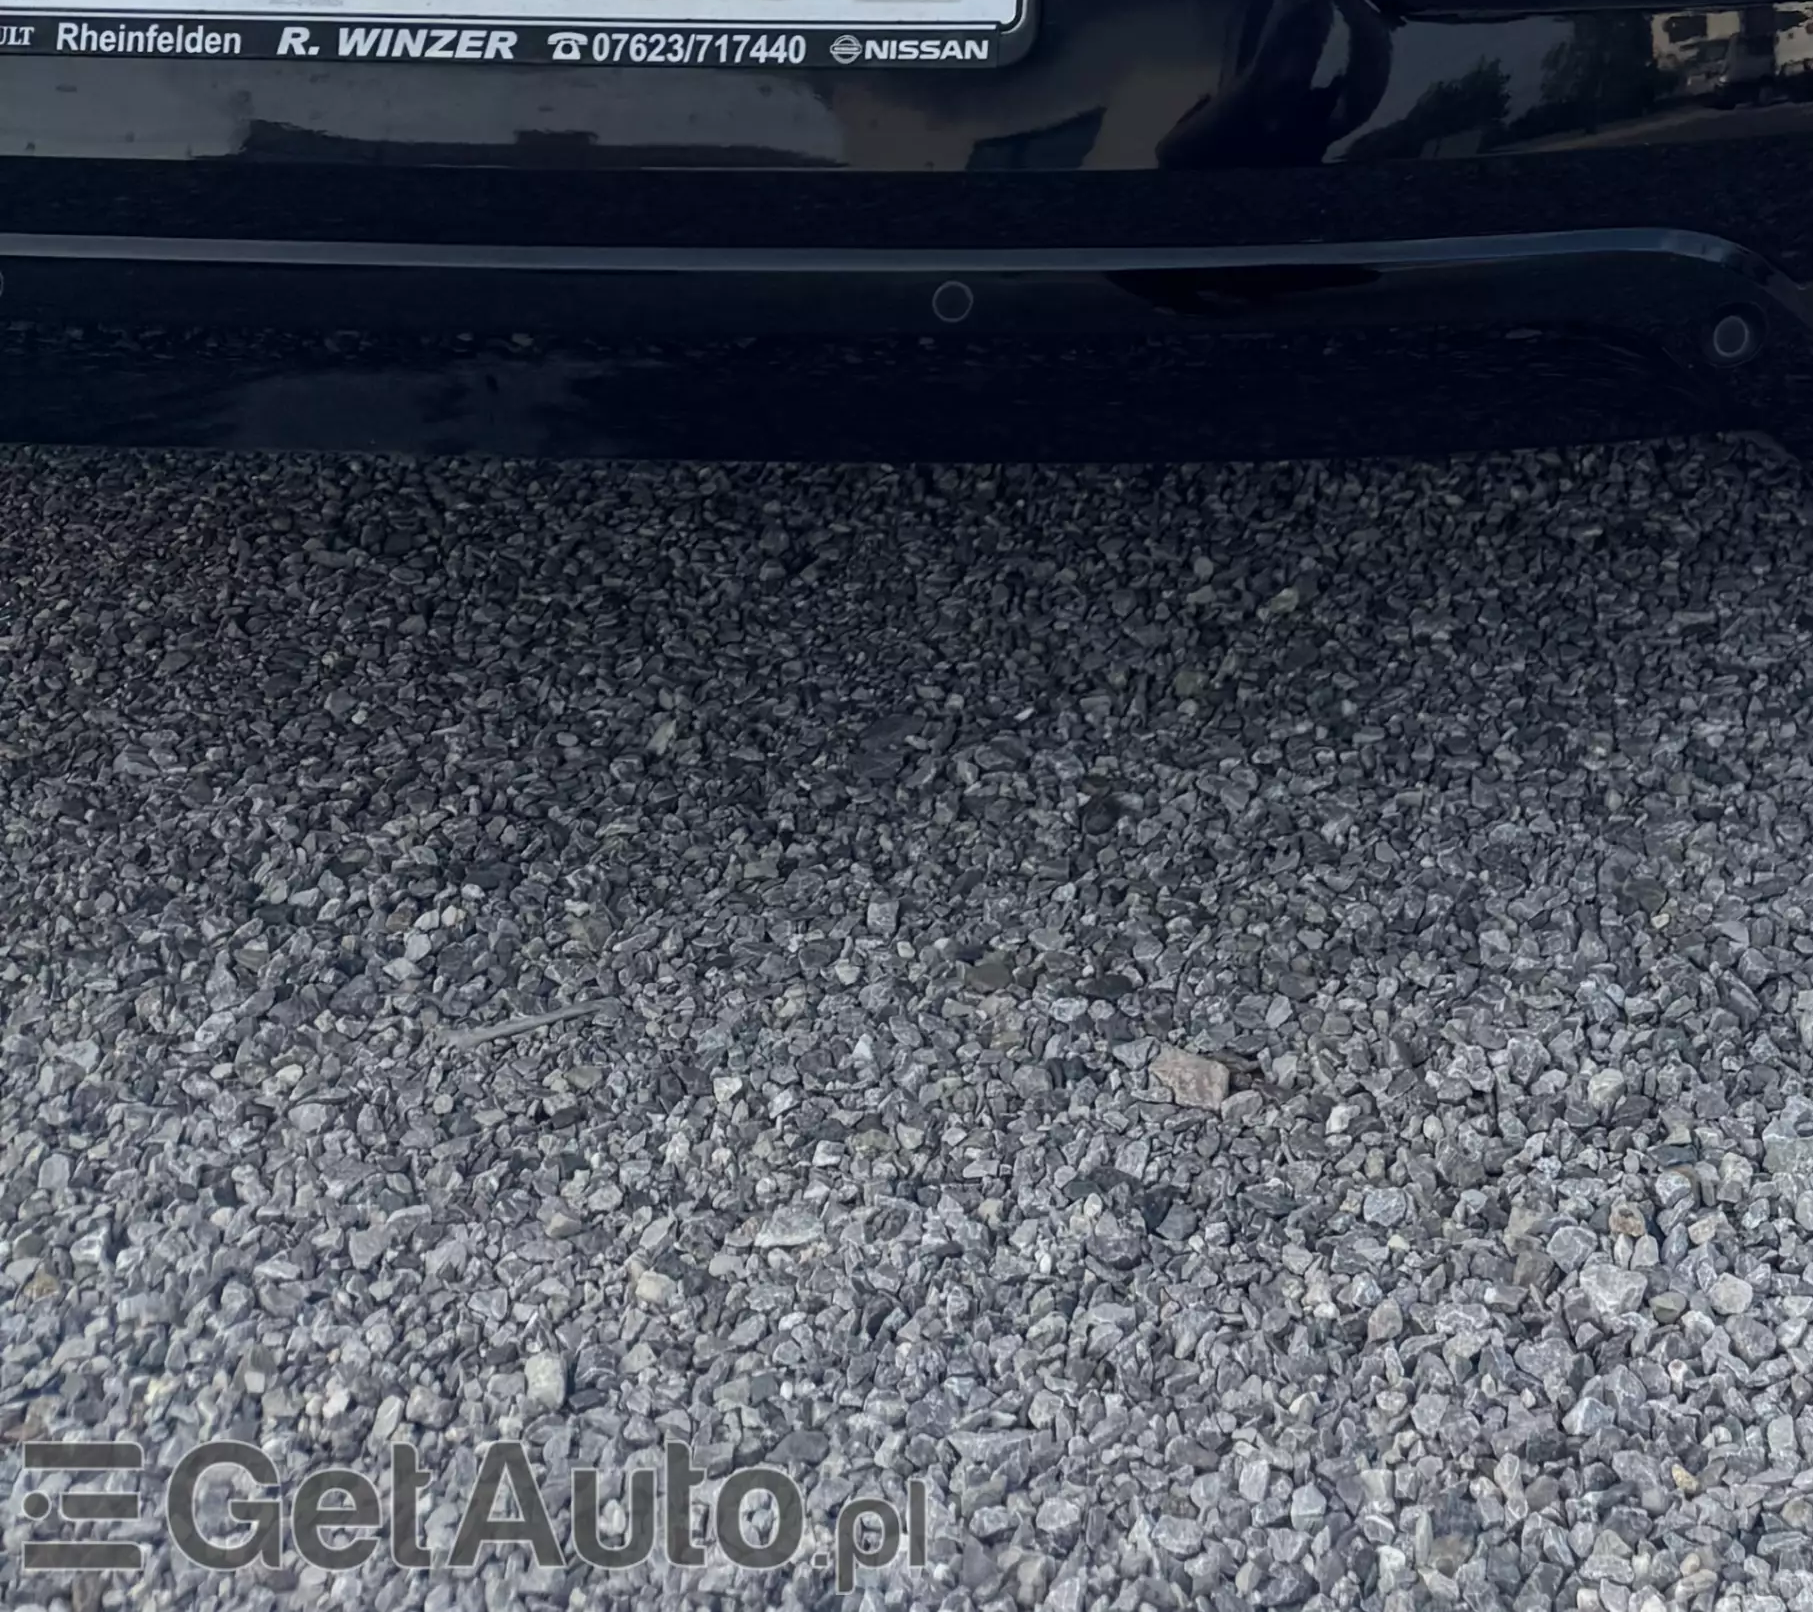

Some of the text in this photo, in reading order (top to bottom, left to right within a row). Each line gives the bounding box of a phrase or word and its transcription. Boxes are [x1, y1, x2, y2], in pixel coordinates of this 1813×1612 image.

[56, 22, 242, 55] Rheinfelden
[277, 26, 320, 57] R.
[338, 27, 518, 60] WINZER
[592, 32, 807, 64] 07623/717440
[864, 39, 989, 60] NISSAN
